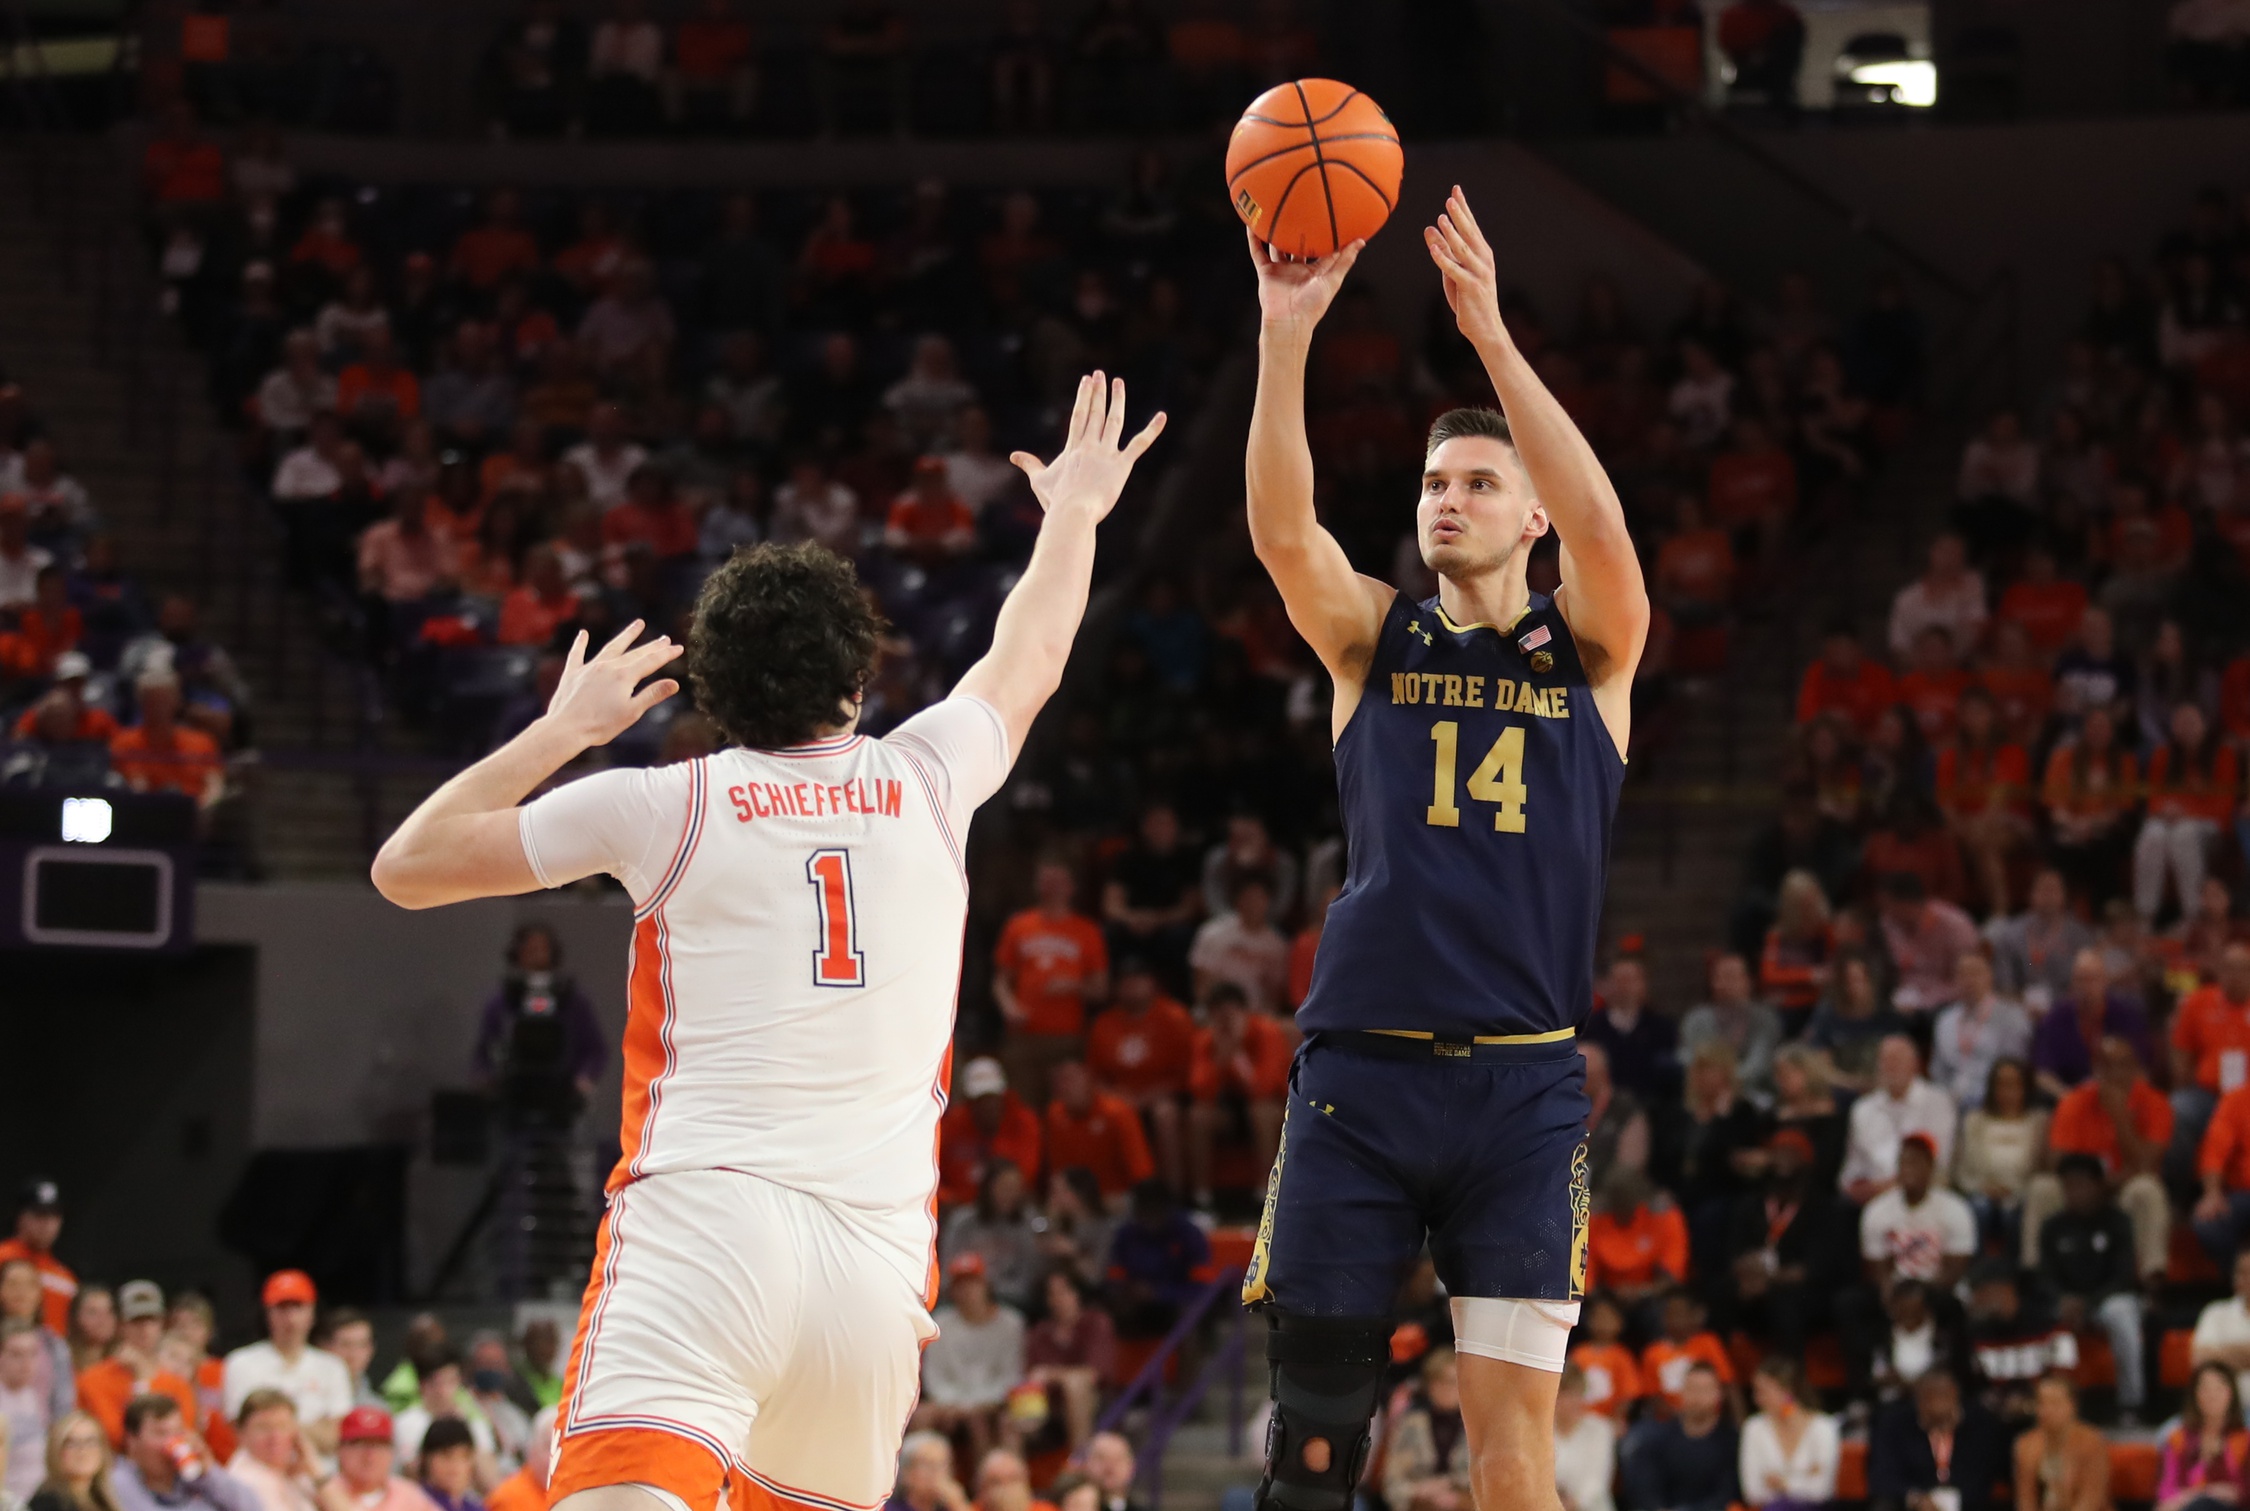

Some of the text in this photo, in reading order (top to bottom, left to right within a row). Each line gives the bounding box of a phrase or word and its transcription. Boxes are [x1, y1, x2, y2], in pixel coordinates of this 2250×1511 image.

[1391, 672, 1570, 718] NOTRE DAME
[728, 777, 902, 823] SCHIEFFELIN
[1426, 719, 1528, 834] 14
[805, 848, 866, 988] 1
